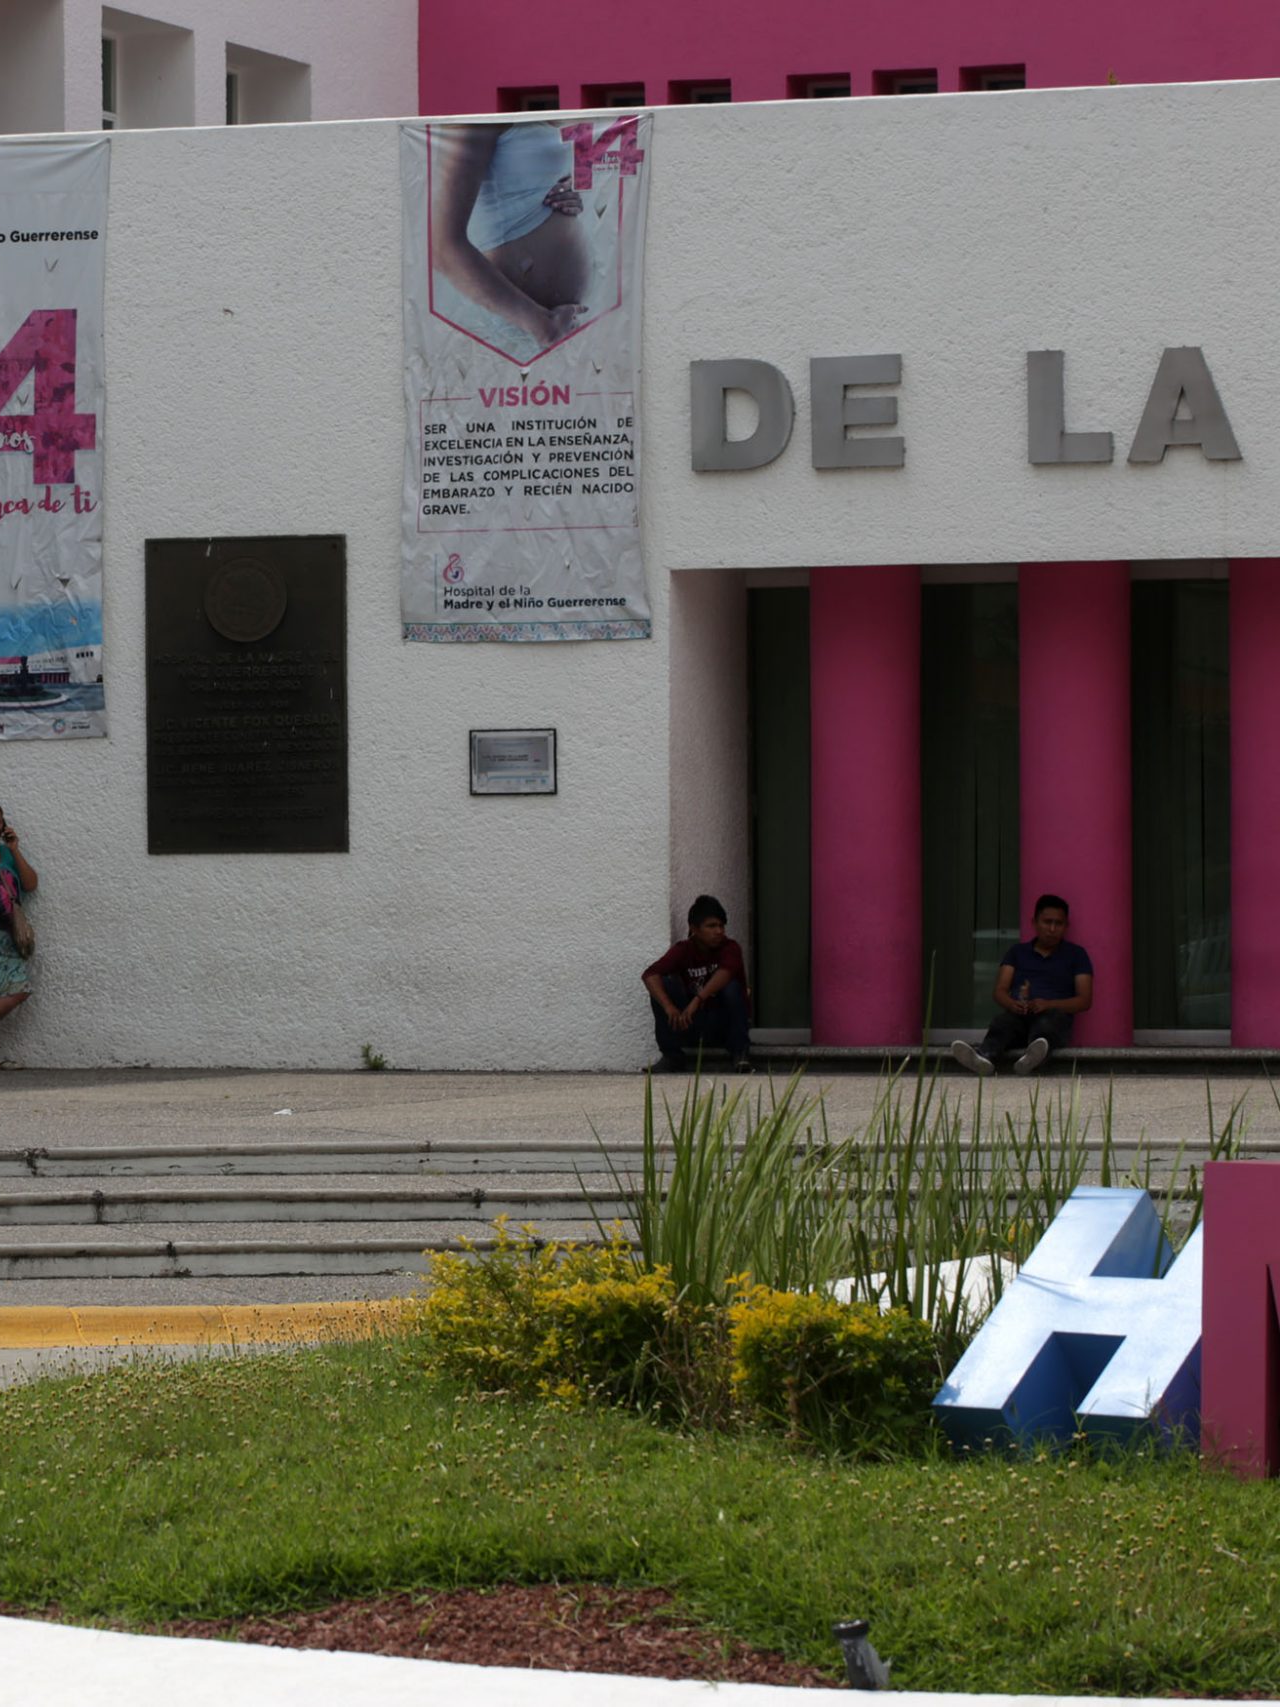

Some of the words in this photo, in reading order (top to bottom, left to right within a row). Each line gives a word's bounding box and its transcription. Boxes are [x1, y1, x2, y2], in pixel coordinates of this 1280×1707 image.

[560, 113, 645, 191] 14
[10, 230, 99, 243] Guerrerense
[479, 380, 570, 408] VISIÓN
[690, 354, 905, 471] DE
[1026, 346, 1244, 464] LA
[424, 424, 447, 435] SER
[466, 422, 496, 434] UNA
[512, 416, 597, 431] INSTITUCIÓN
[617, 417, 633, 428] DE
[424, 438, 503, 451] EXCELENCIA
[506, 437, 524, 448] EN
[528, 436, 546, 447] LA
[549, 432, 634, 447] ENSEÑANZA,
[424, 451, 524, 467] INVESTIGACIÓN
[532, 453, 541, 463] Y
[549, 448, 634, 463] PREVENCIÓN
[423, 472, 440, 483] DE
[450, 471, 474, 482] LAS
[483, 467, 600, 482] COMPLICACIONES
[609, 466, 634, 477] DEL
[38, 486, 66, 513] de
[70, 485, 97, 515] ti
[423, 487, 496, 500] EMBARAZO
[505, 486, 513, 497] Y
[524, 481, 572, 496] RECIÉN
[582, 482, 634, 495] NACIDO
[422, 504, 471, 516] GRAVE.
[444, 586, 495, 598] Hospital
[499, 585, 516, 596] de
[520, 585, 531, 596] la
[444, 598, 484, 610] Madre
[487, 600, 494, 611] y
[499, 598, 510, 609] el
[514, 597, 544, 609] Niño
[547, 597, 626, 609] Guerrerense
